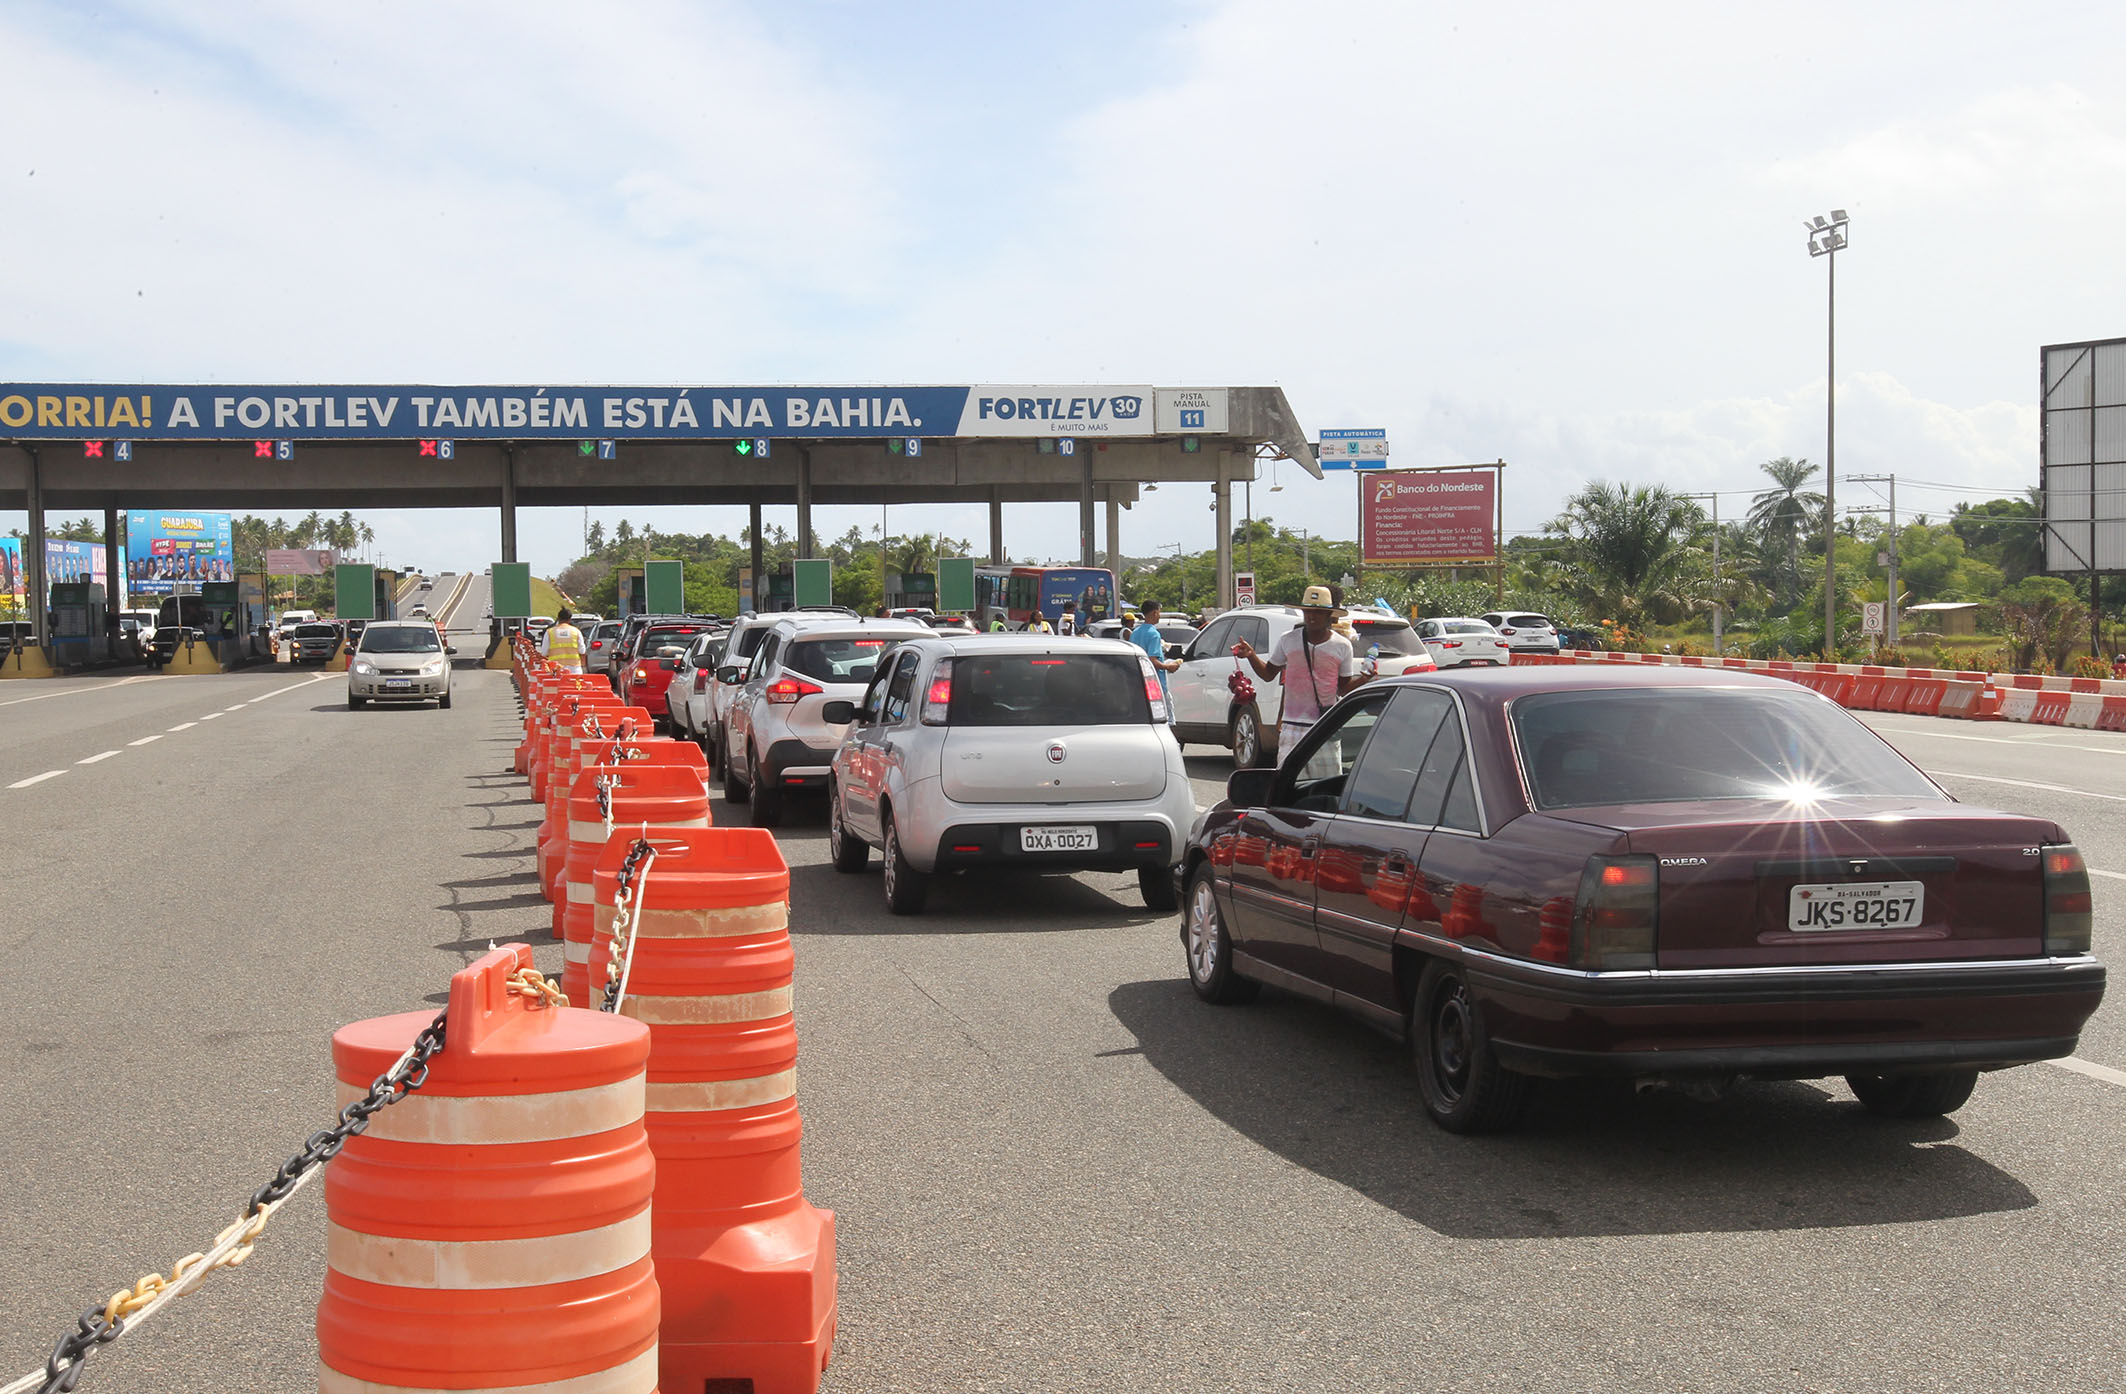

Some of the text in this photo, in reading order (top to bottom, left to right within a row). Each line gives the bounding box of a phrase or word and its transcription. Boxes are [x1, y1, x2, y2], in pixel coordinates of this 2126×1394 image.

[1180, 392, 1203, 400] PISTA
[0, 388, 922, 428] ORRIA! A FORTLEV TAMBÉM ESTÁ NA BAHIA.
[979, 397, 1137, 420] FORTLEV 30
[1173, 400, 1211, 408] MANUAL
[1184, 412, 1201, 425] 11
[1058, 423, 1085, 432] MUITO
[1088, 423, 1109, 432] MAIS
[117, 442, 129, 460] 4
[279, 441, 290, 459] 5
[440, 441, 451, 459] 6
[602, 441, 612, 458] 7
[757, 440, 767, 456] 8
[908, 440, 918, 456] 9
[1060, 440, 1074, 455] 10
[1397, 483, 1484, 494] Banco do Nordeste
[1051, 749, 1062, 759] FIAT
[1660, 857, 1708, 867] OMEGA
